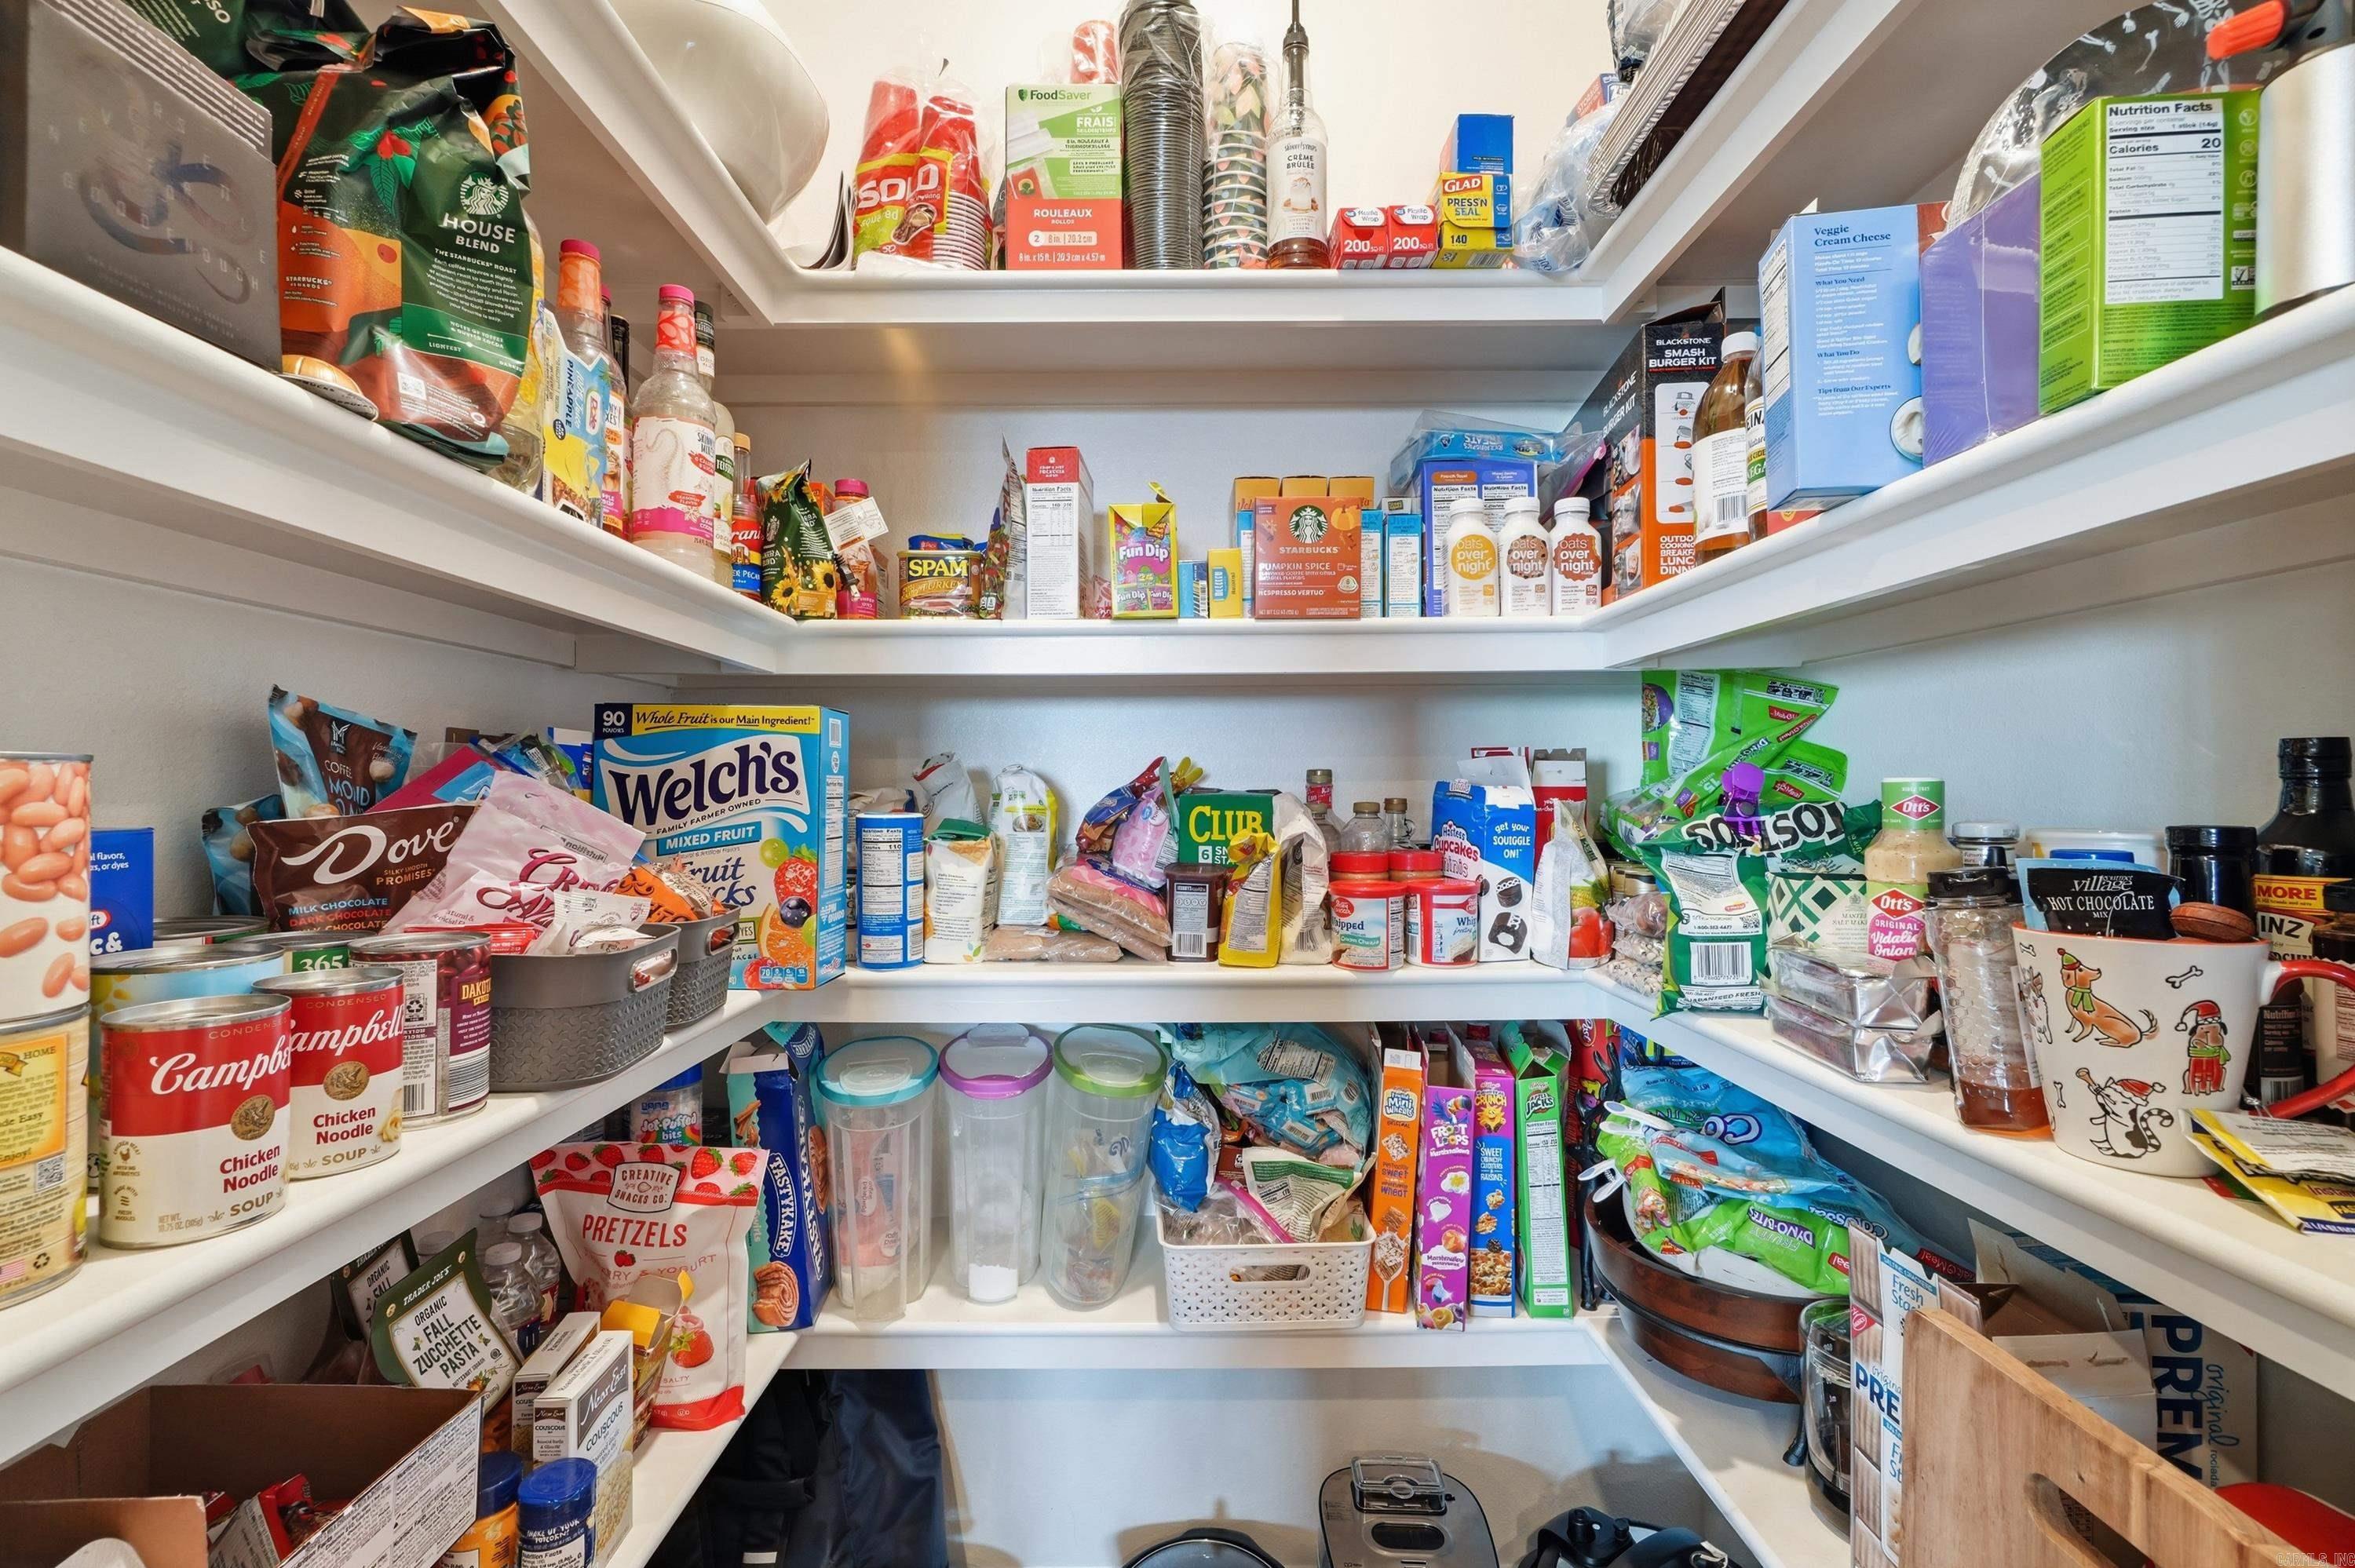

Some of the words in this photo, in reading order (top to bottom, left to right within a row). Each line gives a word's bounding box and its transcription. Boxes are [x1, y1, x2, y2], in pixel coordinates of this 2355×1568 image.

[1030, 89, 1091, 101] FoodSaver
[2109, 106, 2171, 117] Nutrition
[2174, 102, 2214, 113] Facts
[1076, 117, 1114, 127] FRAIS
[2109, 144, 2160, 155] Calories
[2201, 137, 2222, 149] 20
[858, 163, 940, 209] SOLO
[1444, 176, 1482, 193] GLAD
[1447, 198, 1488, 208] PRESS'N
[1034, 209, 1092, 218] ROULEAUX
[1455, 207, 1480, 216] SEAL
[442, 213, 517, 244] HOUSE
[1814, 224, 1849, 236] Veggie
[455, 235, 500, 254] BLEND
[1450, 235, 1467, 245] 140
[1814, 236, 1851, 247] Cream
[1853, 232, 1891, 244] Cheese
[434, 248, 448, 257] THE
[494, 262, 517, 275] ROAST
[1656, 337, 1712, 346] BLACKSTONE
[1664, 348, 1706, 357] SMASH
[1648, 357, 1697, 367] BURGER
[1699, 356, 1717, 366] KIT
[565, 359, 575, 428] PINEAPPLE
[1602, 371, 1637, 418] BLACKSTONE
[1864, 383, 1891, 392] Experts
[1625, 393, 1636, 416] KIT
[1456, 538, 1483, 549] oats
[1512, 538, 1536, 549] oats
[1560, 538, 1587, 549] oats
[1119, 545, 1144, 560] Fun
[1145, 545, 1170, 563] Dip
[1456, 550, 1484, 560] over
[1512, 550, 1539, 560] over
[1560, 550, 1590, 560] over
[908, 558, 969, 577] SPAM
[1258, 563, 1302, 571] PUMPKIN
[1305, 562, 1331, 571] SPICE
[1457, 559, 1491, 574] night
[1512, 559, 1543, 574] night
[1561, 559, 1594, 574] night
[919, 579, 964, 592] TURKEY
[1117, 590, 1130, 602] Fun
[1131, 588, 1146, 601] Dip
[602, 711, 626, 727] 90
[636, 710, 676, 726] Whole
[677, 712, 710, 725] Fruit
[710, 715, 717, 724] is
[719, 717, 735, 725] our
[736, 716, 760, 725] Main
[608, 741, 800, 826] Welch's
[1902, 800, 1930, 814] Ott's
[656, 820, 688, 836] FAMILY
[690, 808, 725, 826] FARMER
[728, 798, 761, 815] OWNED
[1189, 805, 1263, 842] CLUB
[1443, 827, 1466, 841] Hostess
[1495, 823, 1510, 834] get
[1511, 822, 1530, 833] your
[666, 832, 711, 850] MIXED
[714, 826, 756, 844] FRUIT
[1493, 836, 1531, 846] SQUIGGLE
[281, 819, 458, 884] Dove
[1201, 848, 1210, 862] 6
[1434, 835, 1479, 862] Cupcakes
[97, 852, 126, 862] flavors,
[111, 861, 129, 871] dyes
[688, 857, 746, 884] ruit
[376, 869, 433, 886] PROMISES
[2071, 874, 2133, 892] village
[2257, 884, 2317, 900] MORE
[288, 904, 318, 916] MILK
[321, 898, 388, 910] CHOCOLATE
[1880, 895, 1913, 913] Ott's
[2046, 896, 2075, 912] HOT
[2076, 894, 2155, 912] CHOCOLATE
[290, 915, 324, 928] DARK
[327, 908, 392, 922] CHOCOLATE
[1875, 919, 1919, 932] ORIGINAL
[740, 927, 754, 936] YES
[307, 994, 387, 1009] CONDENSED
[291, 1005, 404, 1056] ampbell
[24, 1045, 57, 1060] HOME
[1388, 1096, 1412, 1108] Mini
[1475, 1095, 1507, 1107] CRUNCH
[1525, 1096, 1554, 1119] JACKS
[19, 1111, 44, 1125] Easy
[313, 1107, 376, 1128] Chicken
[1385, 1104, 1415, 1118] Wheats
[641, 1111, 697, 1133] Jet-Puffed
[316, 1124, 374, 1145] Noodle
[662, 1130, 682, 1141] bits
[1430, 1123, 1468, 1138] FROOT
[1435, 1136, 1470, 1148] LOOPS
[220, 1144, 280, 1175] Chicken
[322, 1147, 367, 1166] SOUP
[1481, 1147, 1502, 1157] SWEET
[223, 1163, 279, 1194] Noodle
[621, 1169, 674, 1186] CREATIVE
[229, 1191, 274, 1217] SOUP
[769, 1158, 796, 1257] TASTYKAKE
[582, 1214, 688, 1248] PRETZELS
[638, 1268, 650, 1277] &
[657, 1254, 717, 1275] YOGURT
[367, 1260, 390, 1288] ORGANIC
[403, 1281, 431, 1307] TRADER
[431, 1264, 452, 1285] JOE'S
[1892, 1273, 1924, 1306] Fresh
[414, 1295, 448, 1327] ORGANIC
[422, 1313, 455, 1344] FALL
[412, 1314, 482, 1376] ZUCCHETTE
[439, 1341, 480, 1380] PASTA
[663, 1374, 691, 1385] SALTY
[582, 1386, 610, 1427] Near
[610, 1364, 627, 1393] East
[1854, 1360, 1900, 1425] PRE
[2191, 1363, 2240, 1447] original
[586, 1400, 624, 1452] COUSCOUS
